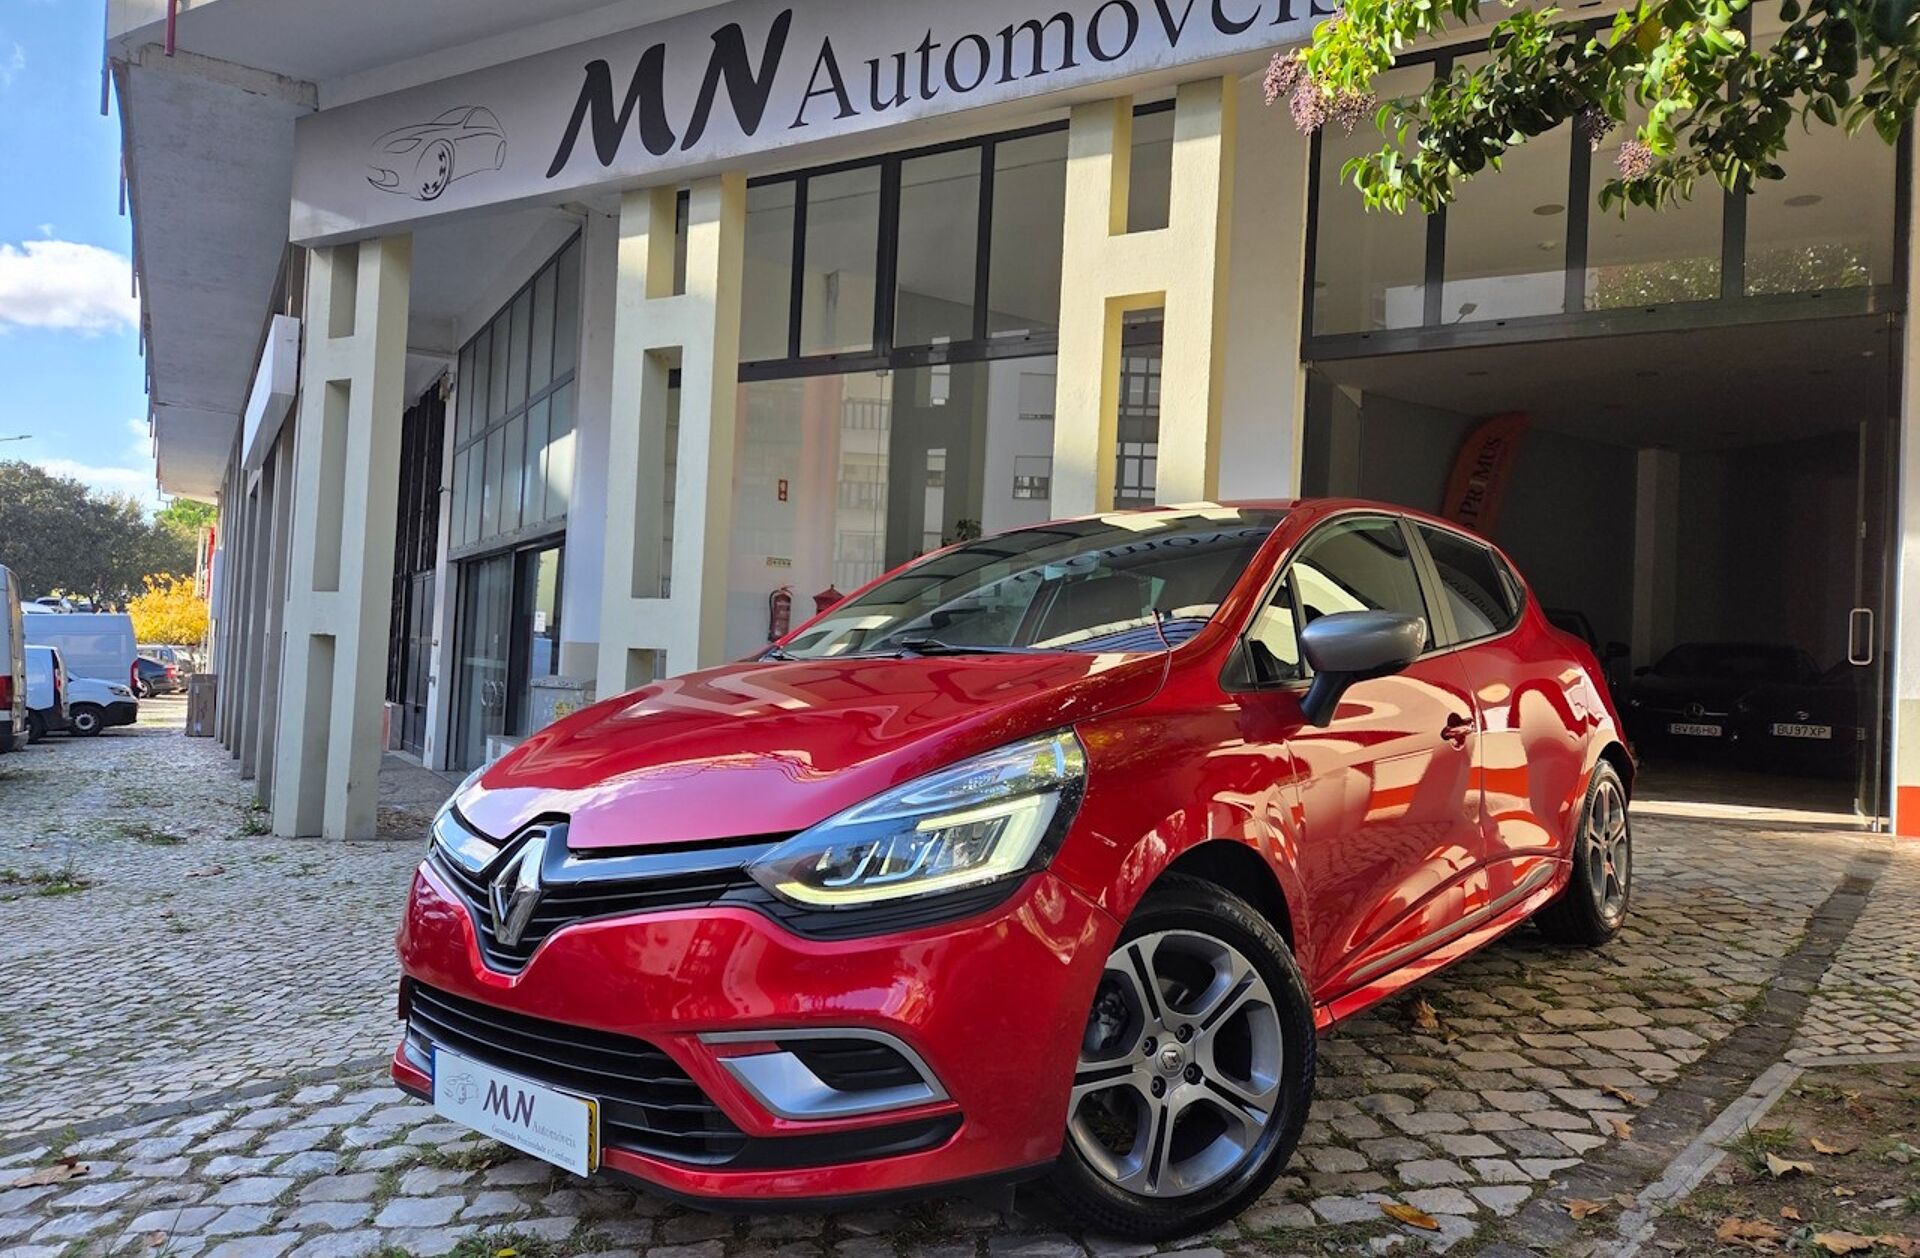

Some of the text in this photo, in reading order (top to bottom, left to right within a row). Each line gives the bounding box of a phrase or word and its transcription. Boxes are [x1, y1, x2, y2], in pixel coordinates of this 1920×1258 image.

[545, 8, 792, 179] MN
[1458, 436, 1502, 517] PRIMUS
[482, 1080, 535, 1128] MN
